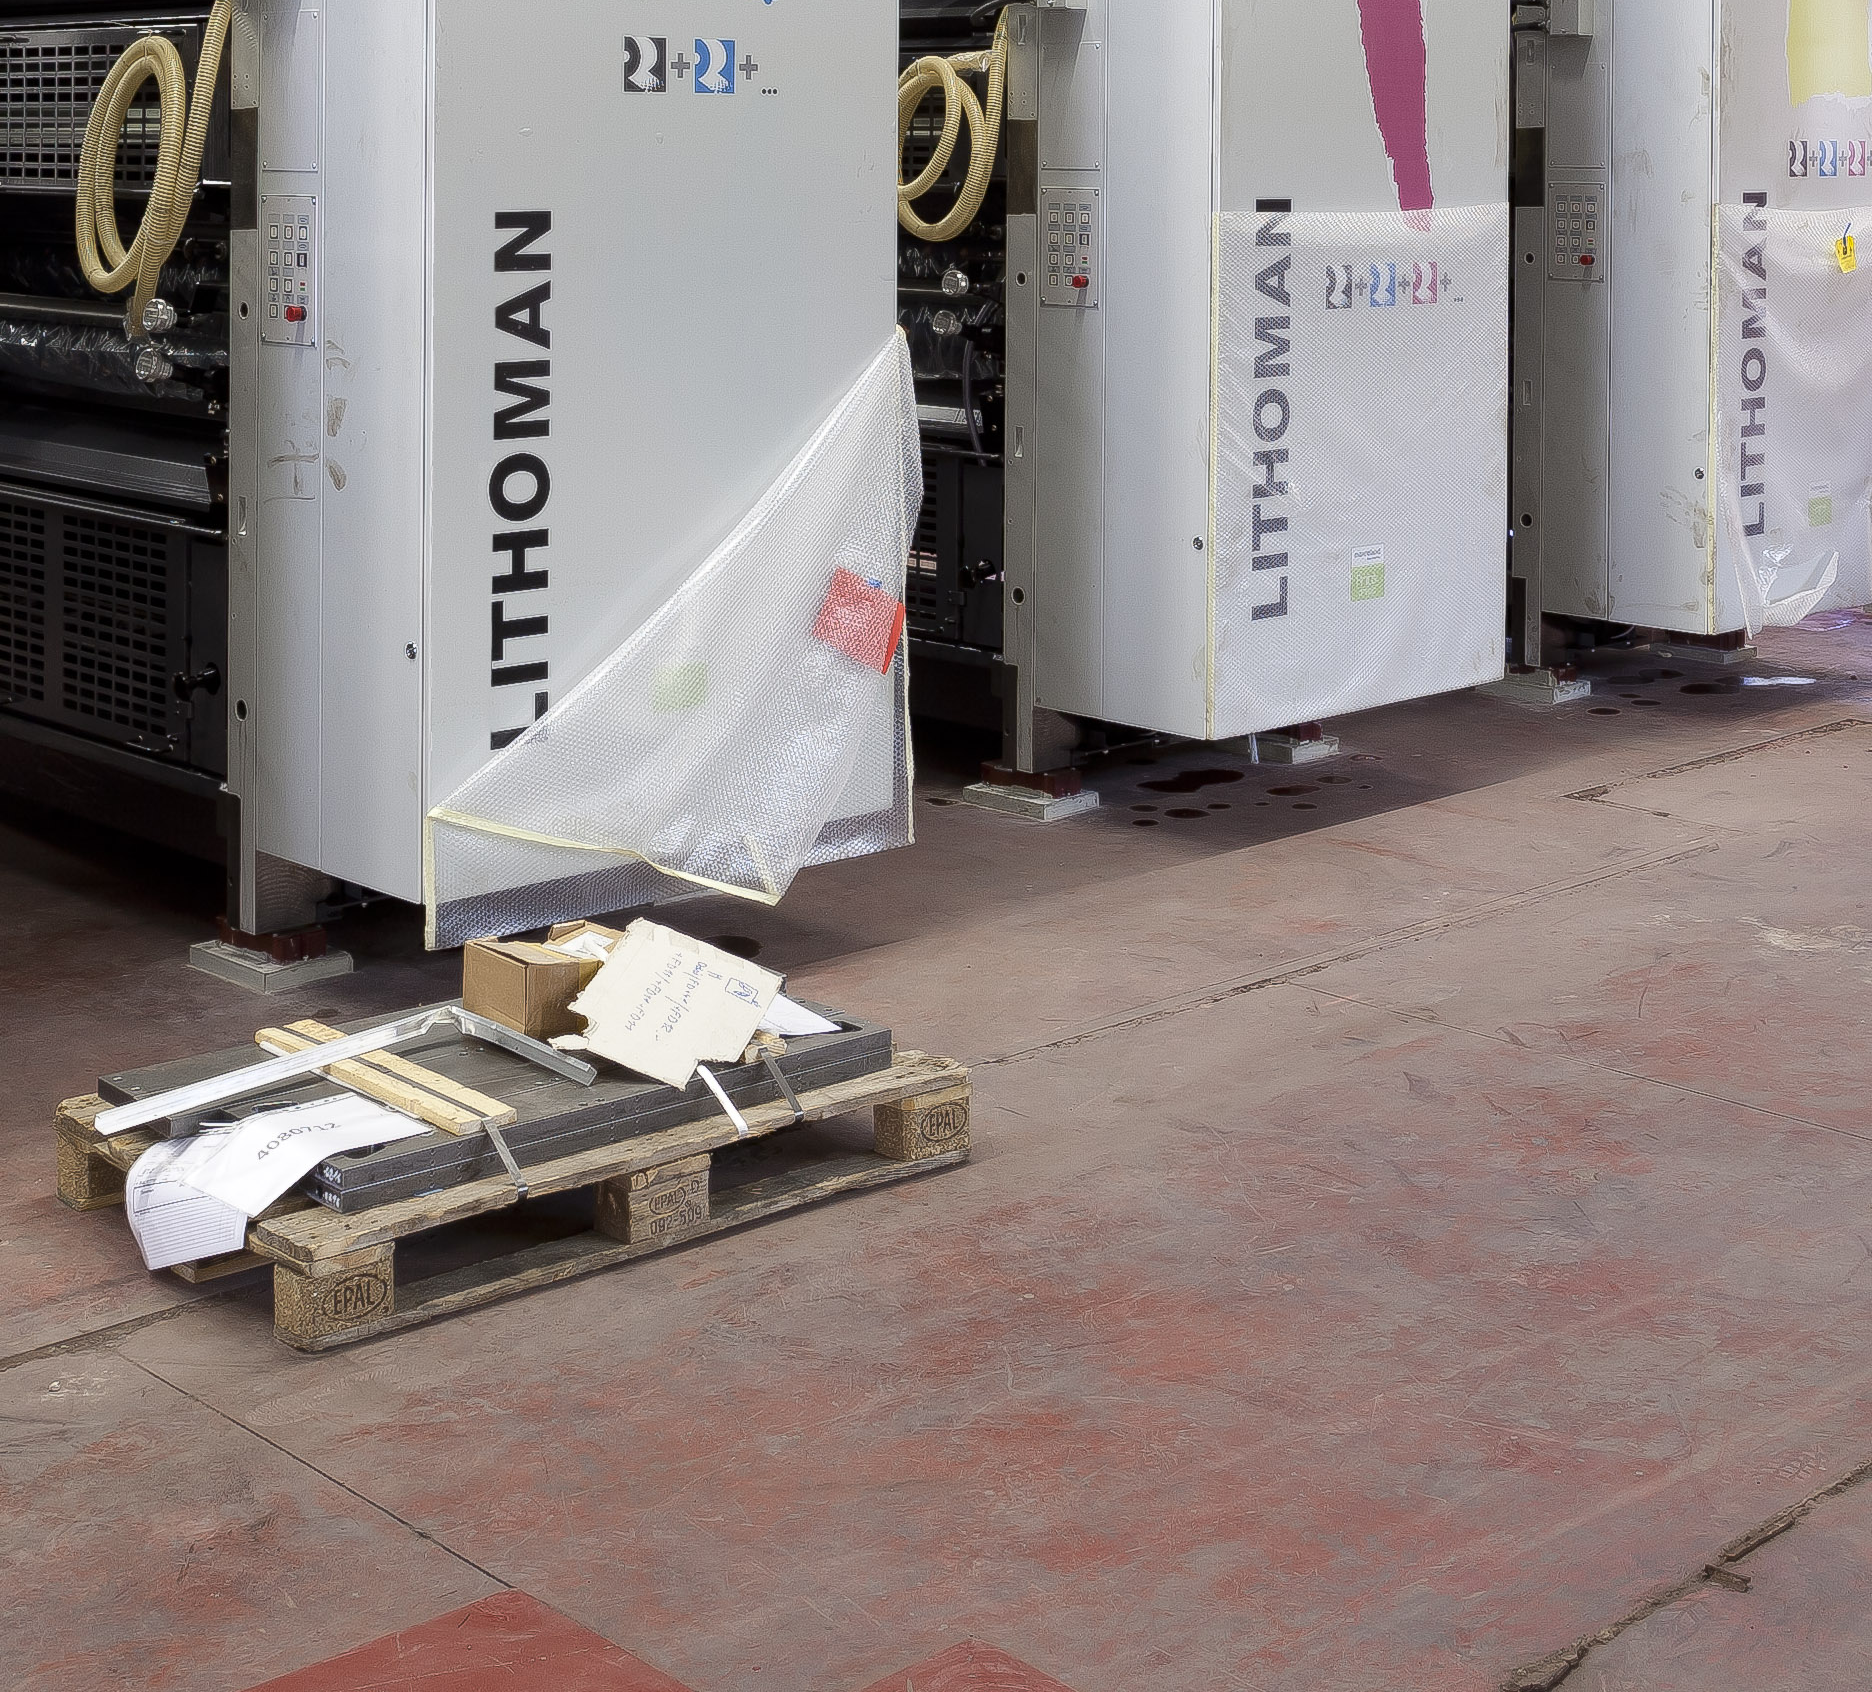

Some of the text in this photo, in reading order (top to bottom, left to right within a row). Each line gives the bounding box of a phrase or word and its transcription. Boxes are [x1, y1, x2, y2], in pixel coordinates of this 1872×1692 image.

[1251, 198, 1293, 622] LITHOMAN
[1739, 190, 1769, 538] LITHOMAN
[486, 210, 554, 750] LITHOMAN
[653, 1190, 683, 1212] EPAL
[928, 1105, 960, 1138] EPAL
[332, 1277, 378, 1316] EPAL
